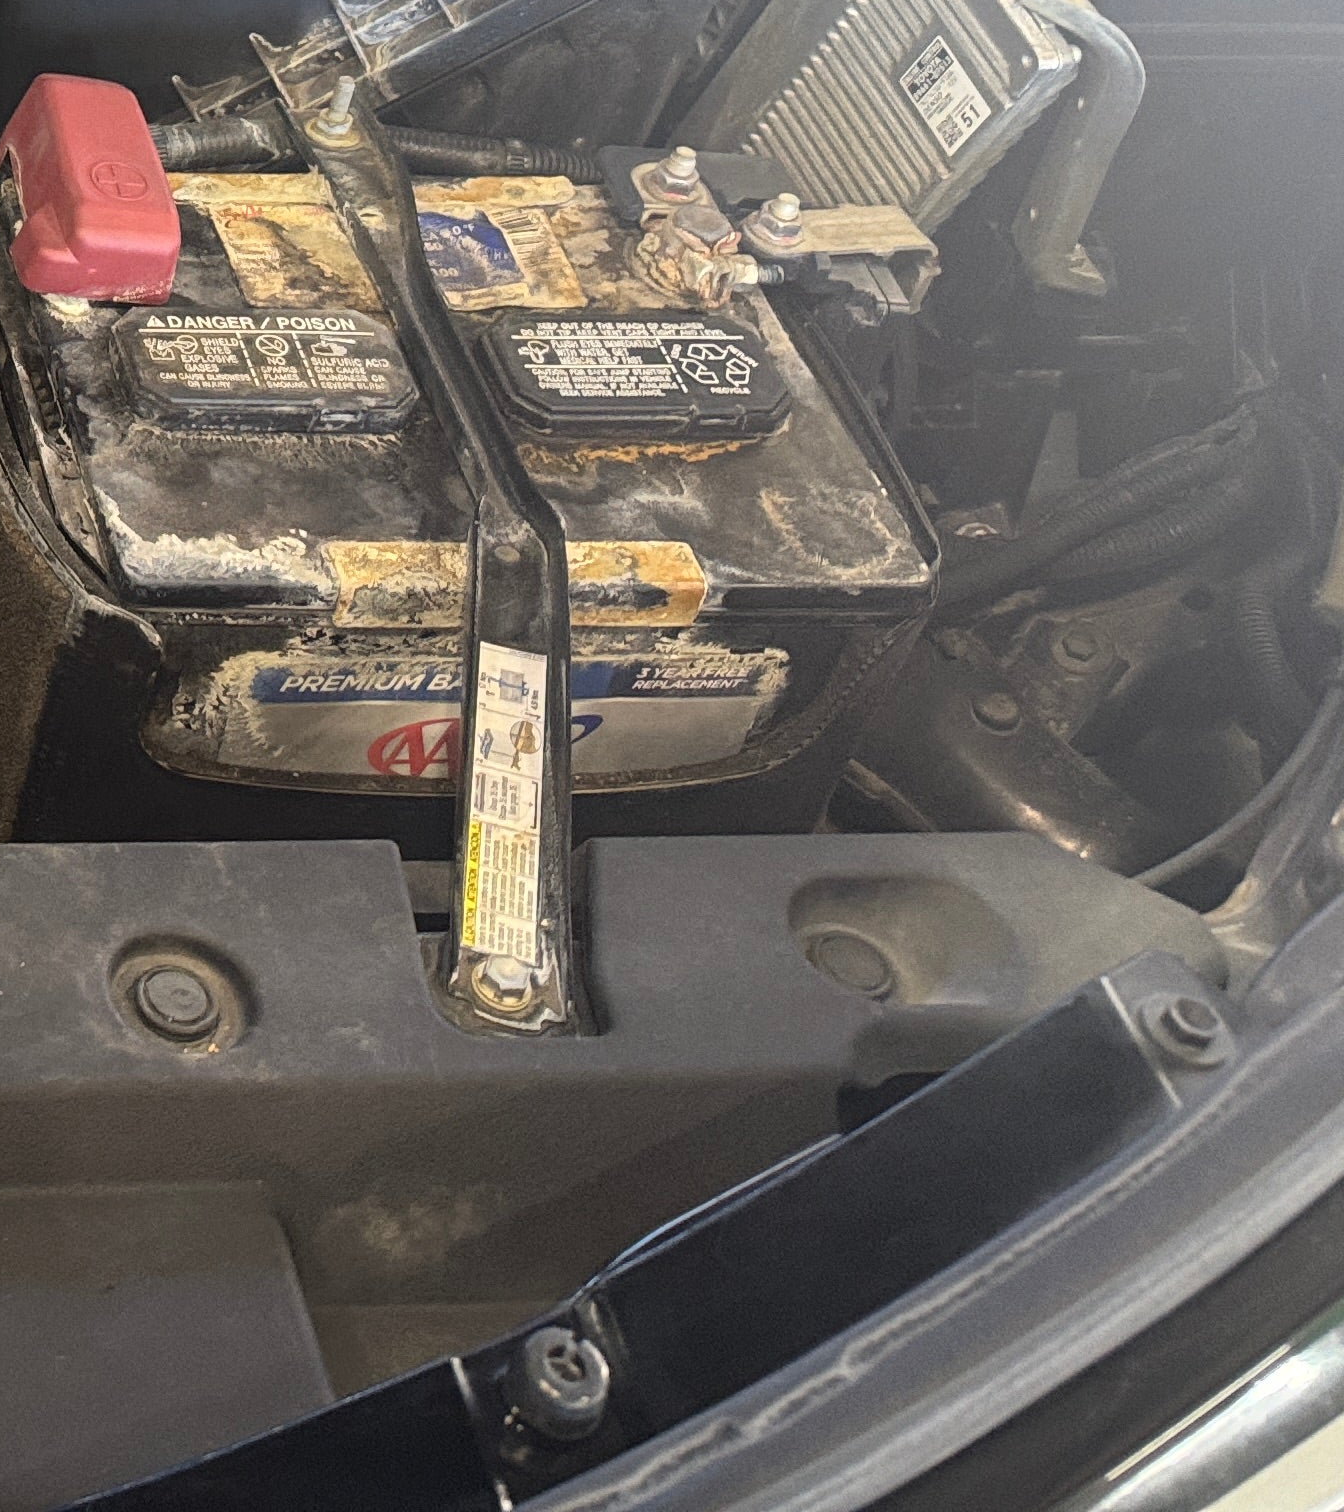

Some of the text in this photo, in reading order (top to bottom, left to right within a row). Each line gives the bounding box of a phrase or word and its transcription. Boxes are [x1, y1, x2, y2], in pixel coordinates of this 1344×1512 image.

[913, 56, 942, 87] TOYOTA
[959, 103, 981, 129] 51
[166, 315, 357, 331] DANGER / POISON
[536, 321, 558, 330] KEEP
[560, 321, 579, 330] OUT
[581, 321, 594, 330] OF
[596, 321, 614, 330] THE
[615, 321, 645, 330] REACH
[646, 321, 659, 330] OF
[200, 337, 240, 347] SHIELD
[550, 339, 579, 348] FLUSH
[579, 339, 602, 348] EYES
[203, 346, 232, 355] EYES
[180, 354, 240, 364] EXPLOSIVE
[266, 356, 287, 366] NO
[310, 357, 390, 368] SULFURIC ACID
[184, 363, 220, 373] GASES
[260, 365, 298, 374] SPARKS
[313, 366, 367, 375] CAN CAUSE
[159, 372, 178, 381] CAN
[263, 373, 301, 381] FLAMES
[635, 666, 754, 679] 3 YEAR FREE
[279, 673, 427, 693] PREMIUM
[631, 678, 745, 690] REPLACEMENT
